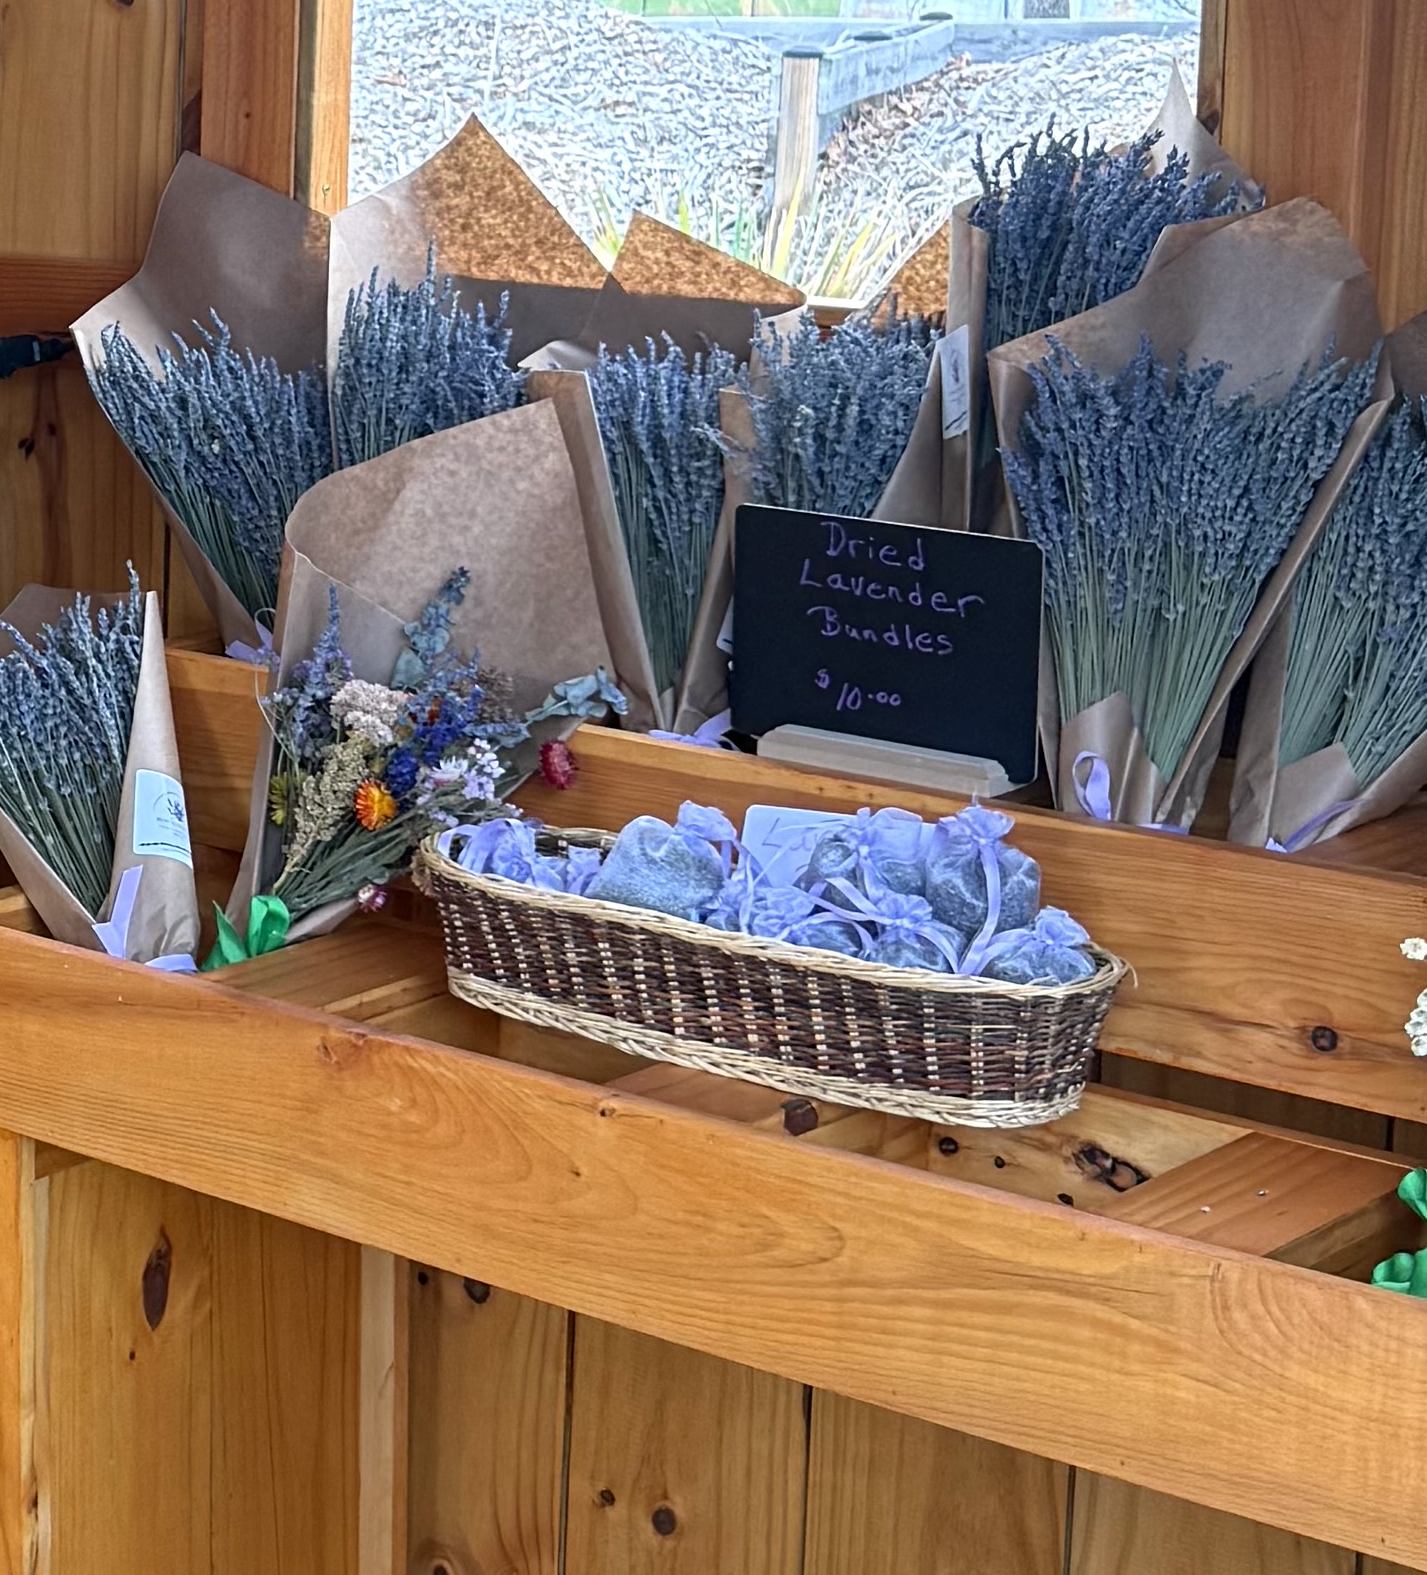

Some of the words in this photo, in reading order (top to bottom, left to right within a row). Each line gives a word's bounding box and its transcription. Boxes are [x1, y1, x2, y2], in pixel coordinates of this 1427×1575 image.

[820, 521, 925, 571] Dried
[799, 558, 985, 617] Lavender
[807, 606, 953, 655] Bundles
